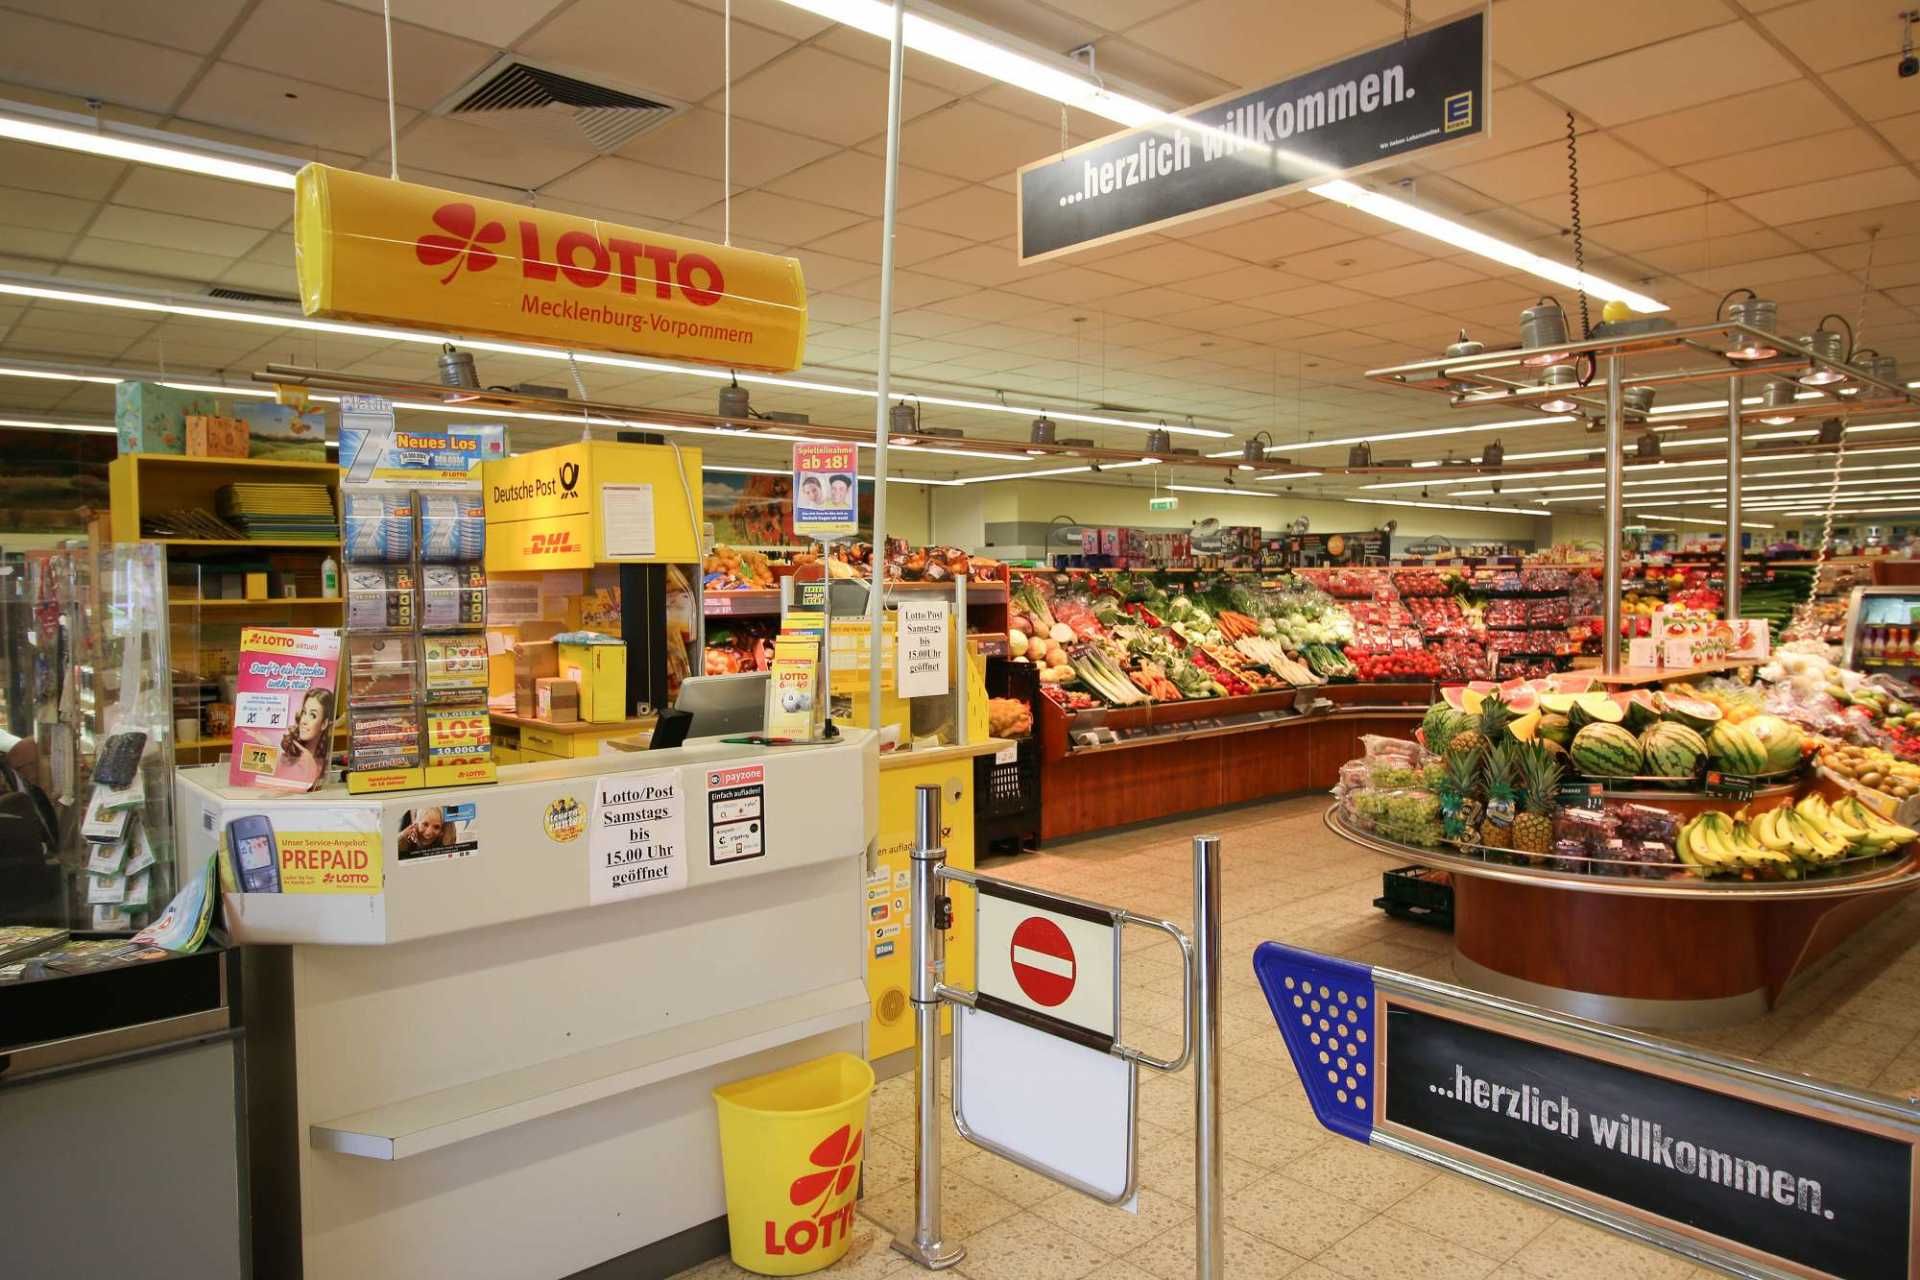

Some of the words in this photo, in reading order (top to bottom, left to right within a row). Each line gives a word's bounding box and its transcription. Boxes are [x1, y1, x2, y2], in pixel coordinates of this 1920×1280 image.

[1059, 127, 1191, 207] ...herzlich
[1200, 64, 1416, 163] willkommen.
[519, 220, 725, 306] LOTTO
[521, 293, 754, 345] Mecklenburg-Vorpommern
[396, 433, 446, 449] Neues
[450, 435, 477, 450] Los
[802, 454, 821, 469] ab
[824, 454, 849, 469] 18!
[493, 480, 534, 504] Deutsche
[535, 478, 557, 496] Post
[531, 531, 573, 554] DHL
[907, 624, 941, 633] Samstags
[262, 634, 295, 648] LOTTO
[919, 636, 931, 645] bis
[779, 672, 809, 681] LOTTO
[909, 662, 940, 674] geöffnet
[779, 681, 785, 689] 6
[436, 719, 485, 740] LOS
[438, 746, 475, 755] 10.000
[725, 770, 761, 785] payzone
[601, 784, 675, 805] Lotto/Post
[711, 790, 733, 801] Einfach
[603, 807, 669, 826] Samstags
[630, 827, 650, 841] bis
[281, 839, 304, 847] Unser
[282, 849, 369, 870] PREPAID
[606, 847, 643, 866] 15.00
[646, 844, 674, 860] Uhr
[336, 873, 369, 884] LOTTO
[611, 864, 669, 888] geöffnet
[1429, 1063, 1579, 1139] ...herzlich
[1590, 1113, 1835, 1221] willkommen.
[765, 1201, 856, 1256] LOTT
